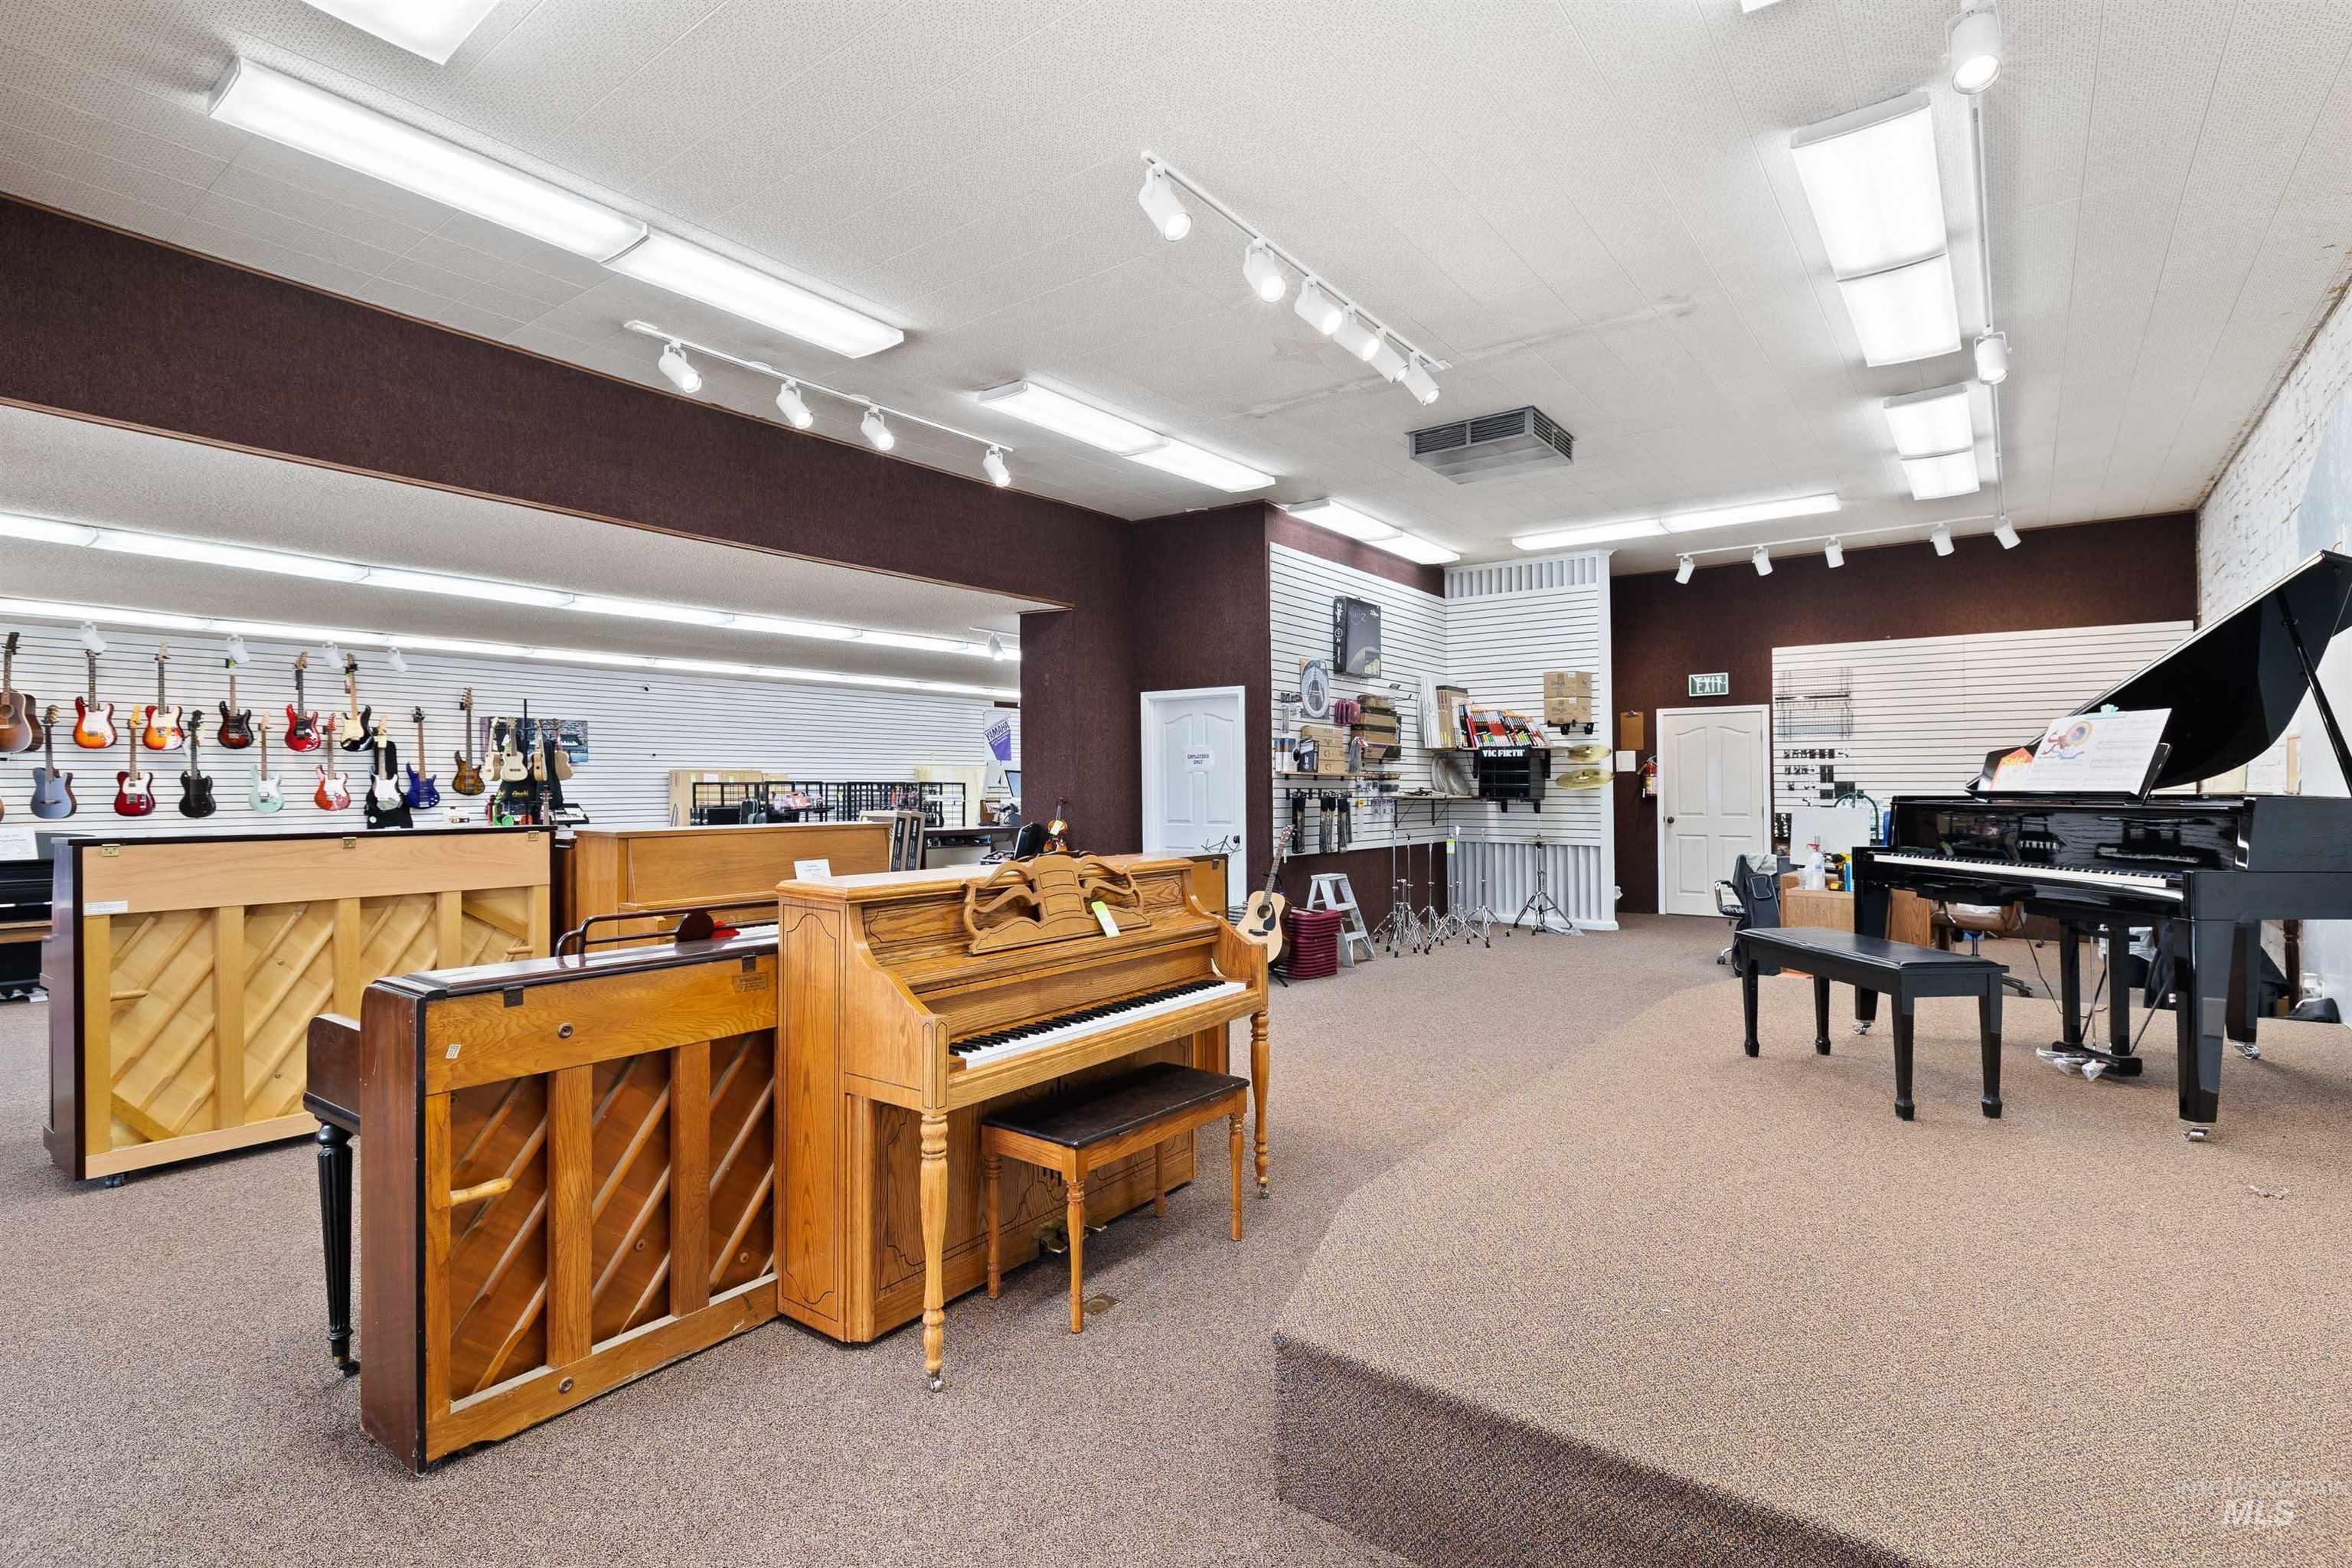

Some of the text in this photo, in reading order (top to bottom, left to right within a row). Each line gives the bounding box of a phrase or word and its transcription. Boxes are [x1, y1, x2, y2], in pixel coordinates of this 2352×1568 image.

[1697, 676, 1722, 693] EXIT
[985, 720, 1011, 741] YAMAHA
[2020, 840, 2058, 850] YAMAHA
